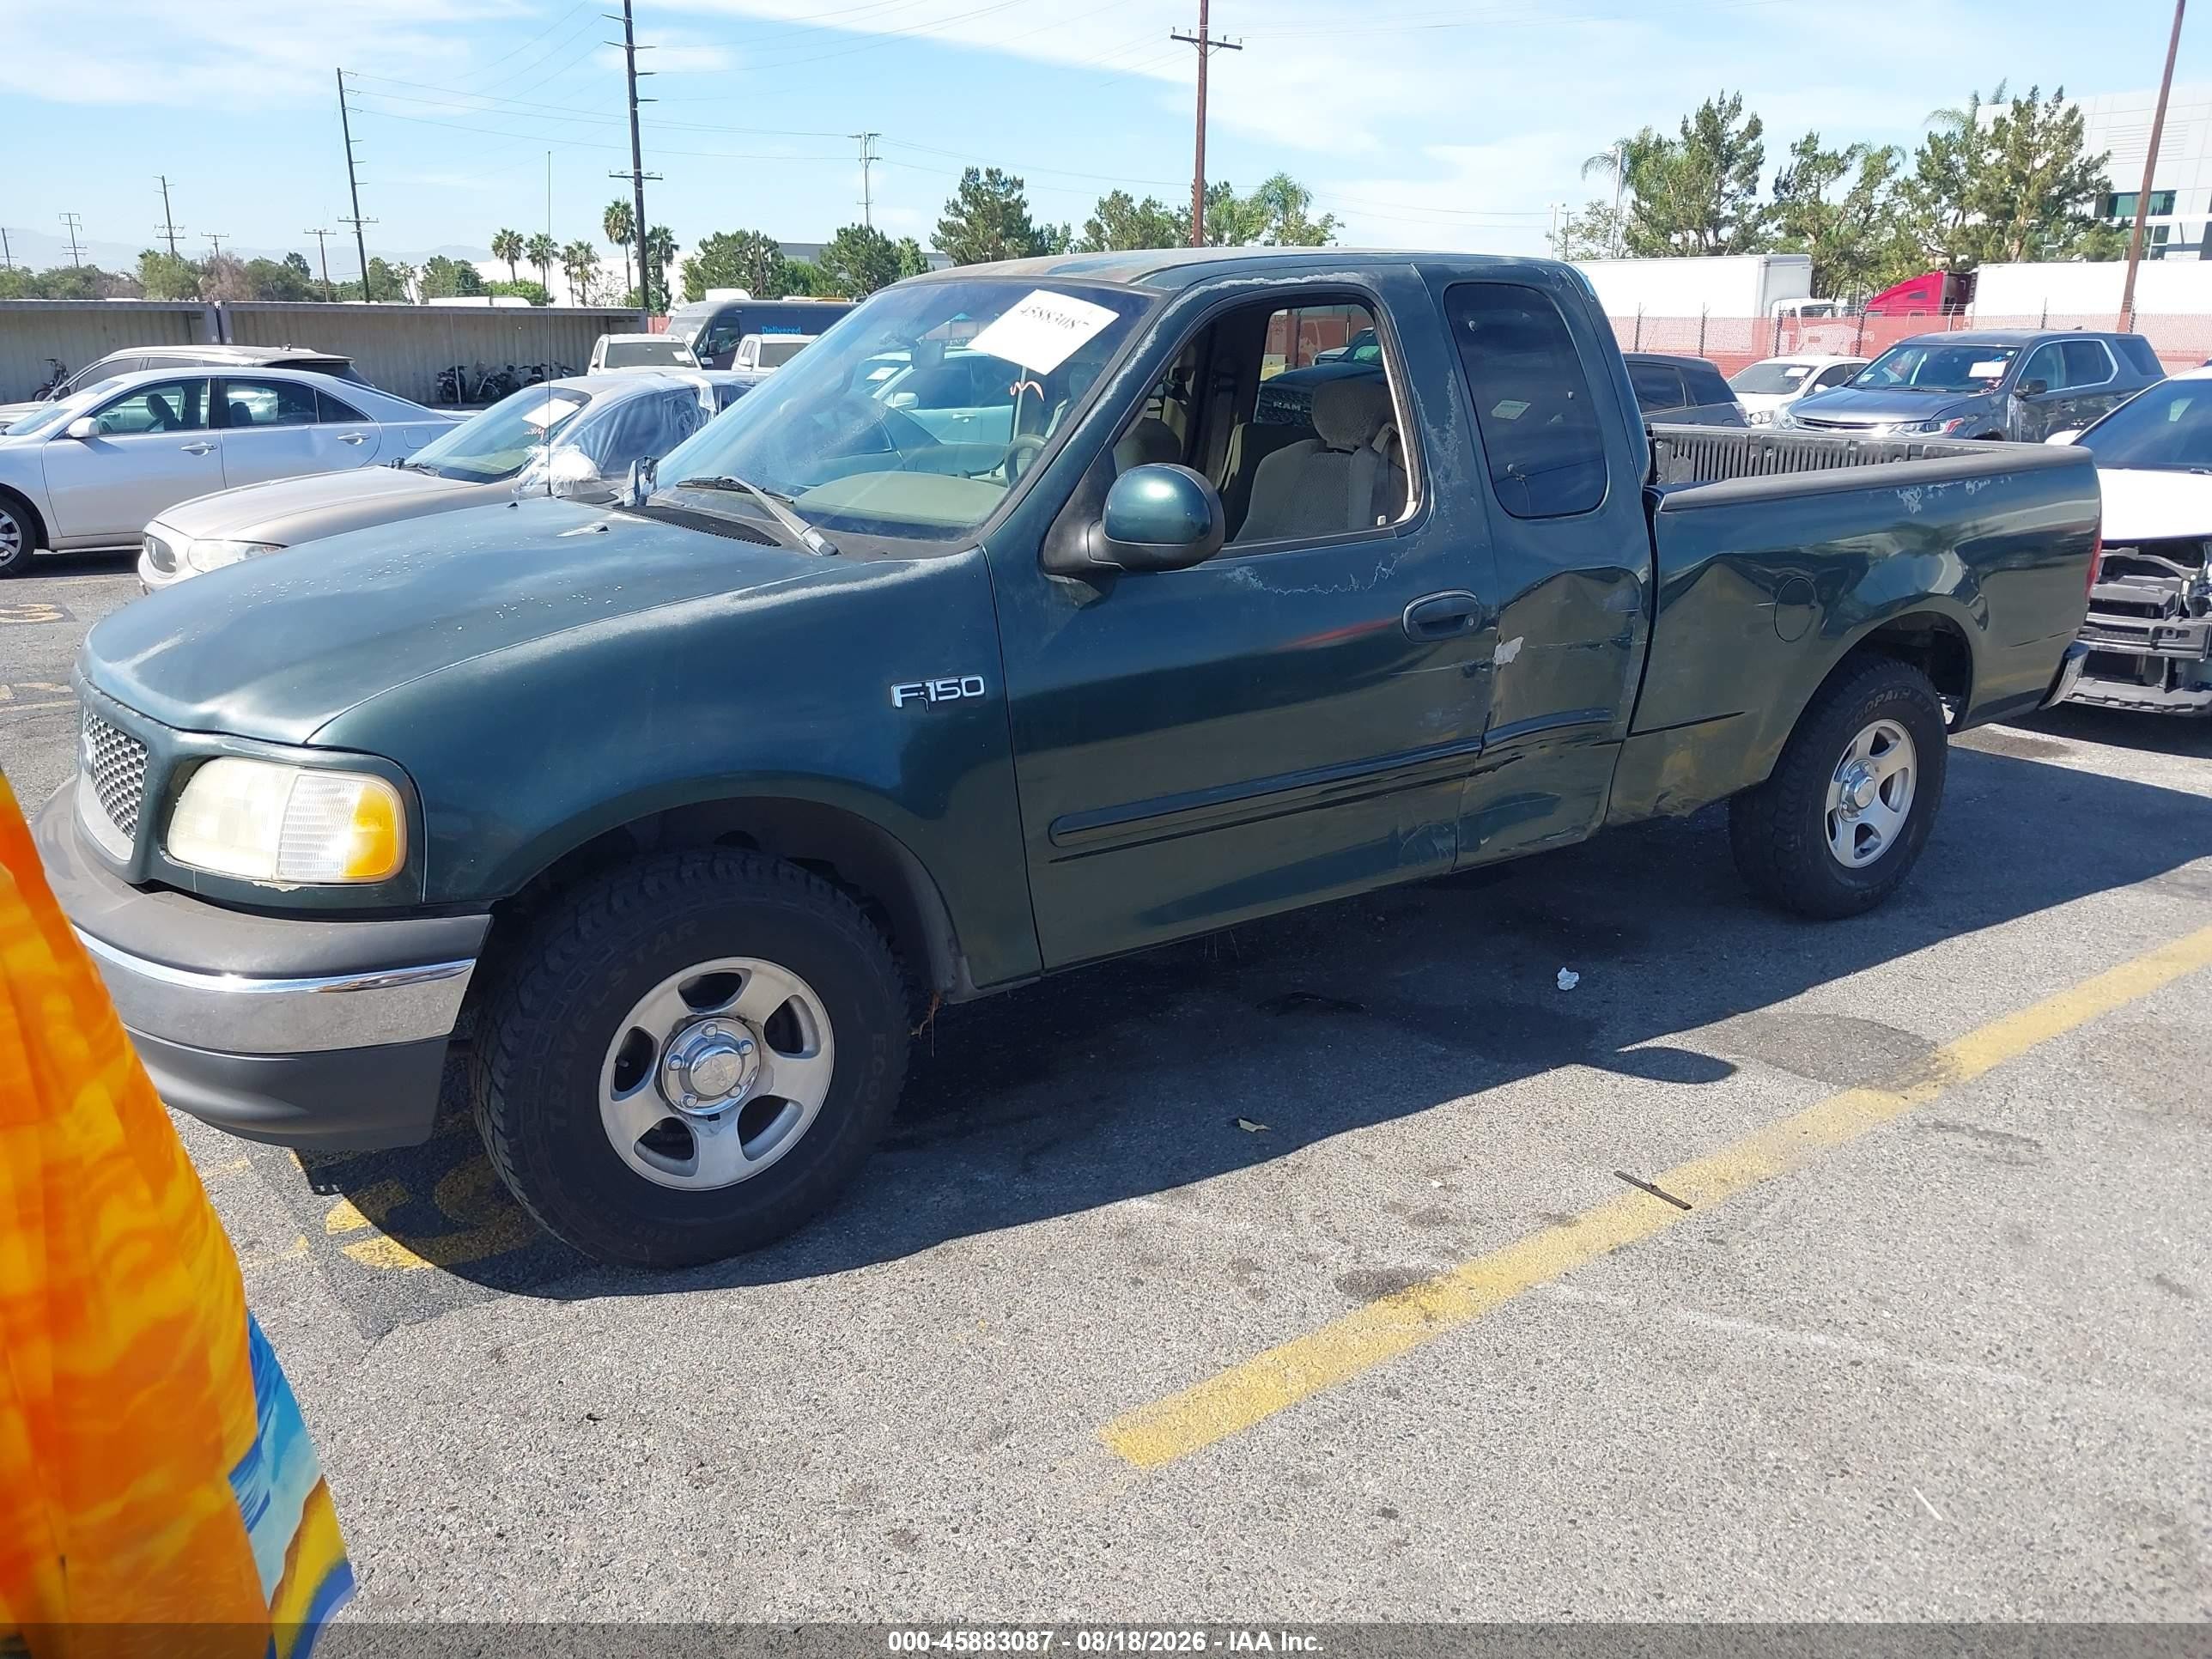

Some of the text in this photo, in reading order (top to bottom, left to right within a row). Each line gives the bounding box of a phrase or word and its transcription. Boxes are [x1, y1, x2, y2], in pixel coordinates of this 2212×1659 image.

[762, 325, 801, 334] Delivered
[1273, 401, 1302, 411] RAM
[892, 675, 985, 708] F-150
